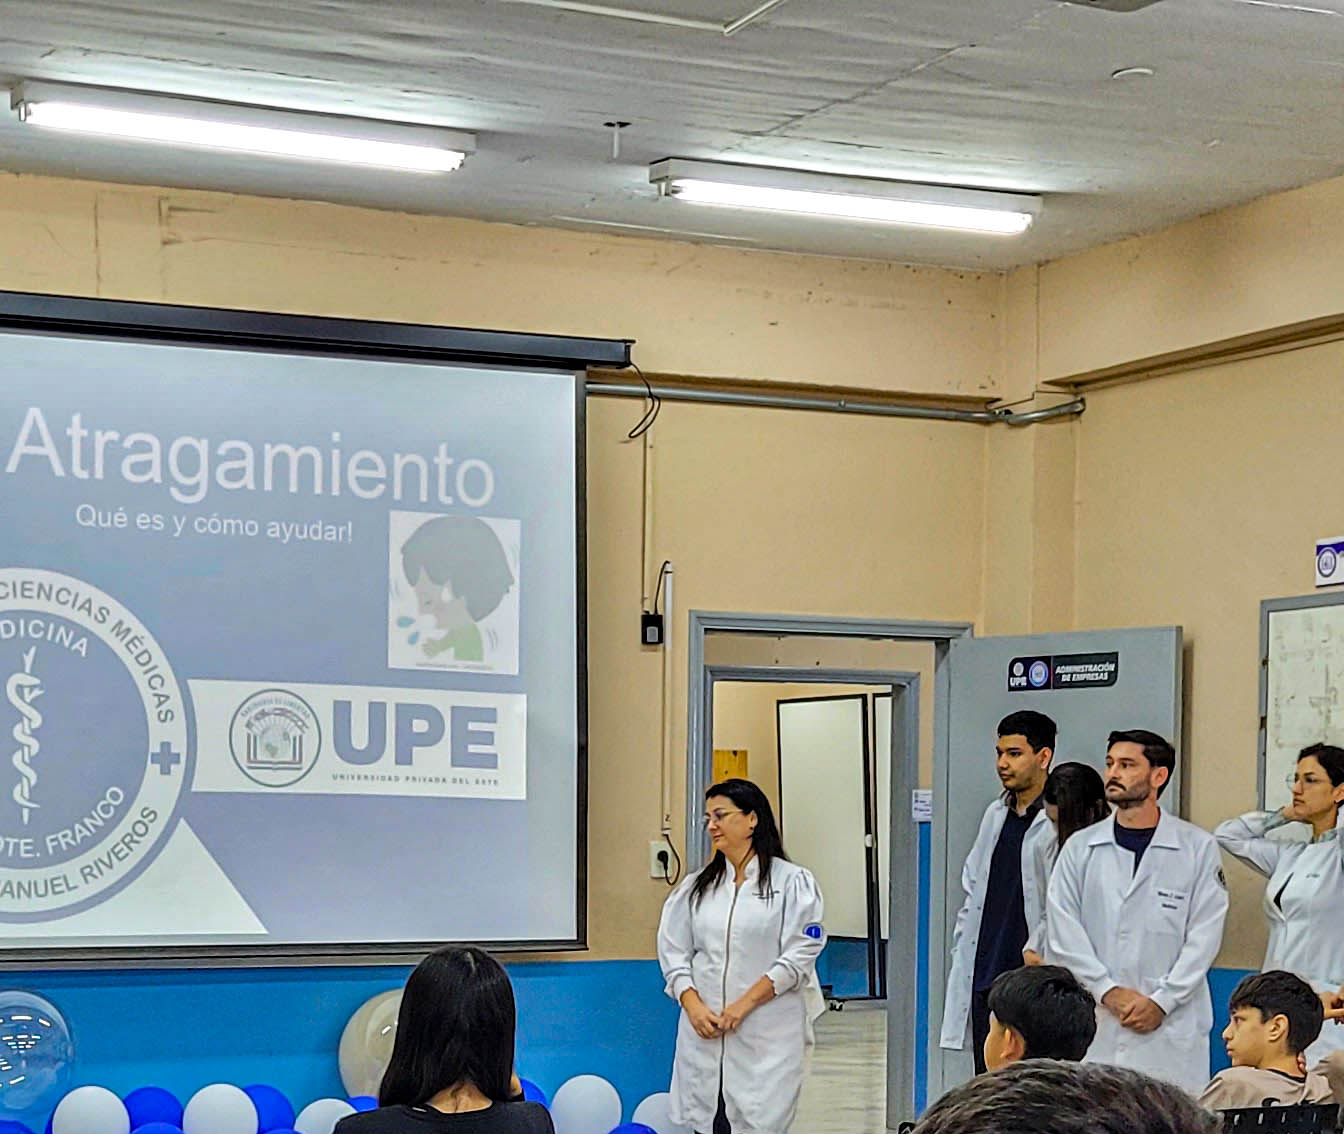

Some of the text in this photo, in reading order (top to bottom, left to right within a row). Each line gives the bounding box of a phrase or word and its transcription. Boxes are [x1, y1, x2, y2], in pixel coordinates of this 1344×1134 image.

[5, 407, 495, 507] Atragamiento
[75, 503, 353, 544] Qué es y cómo ayudar!
[110, 619, 174, 724] MÉDICAS
[332, 700, 499, 770] UPE
[332, 773, 499, 786] UNIVERSIDAD PRIVADA DEL ESTE
[46, 786, 125, 855] FRANCO
[80, 806, 159, 885] RIVEROS
